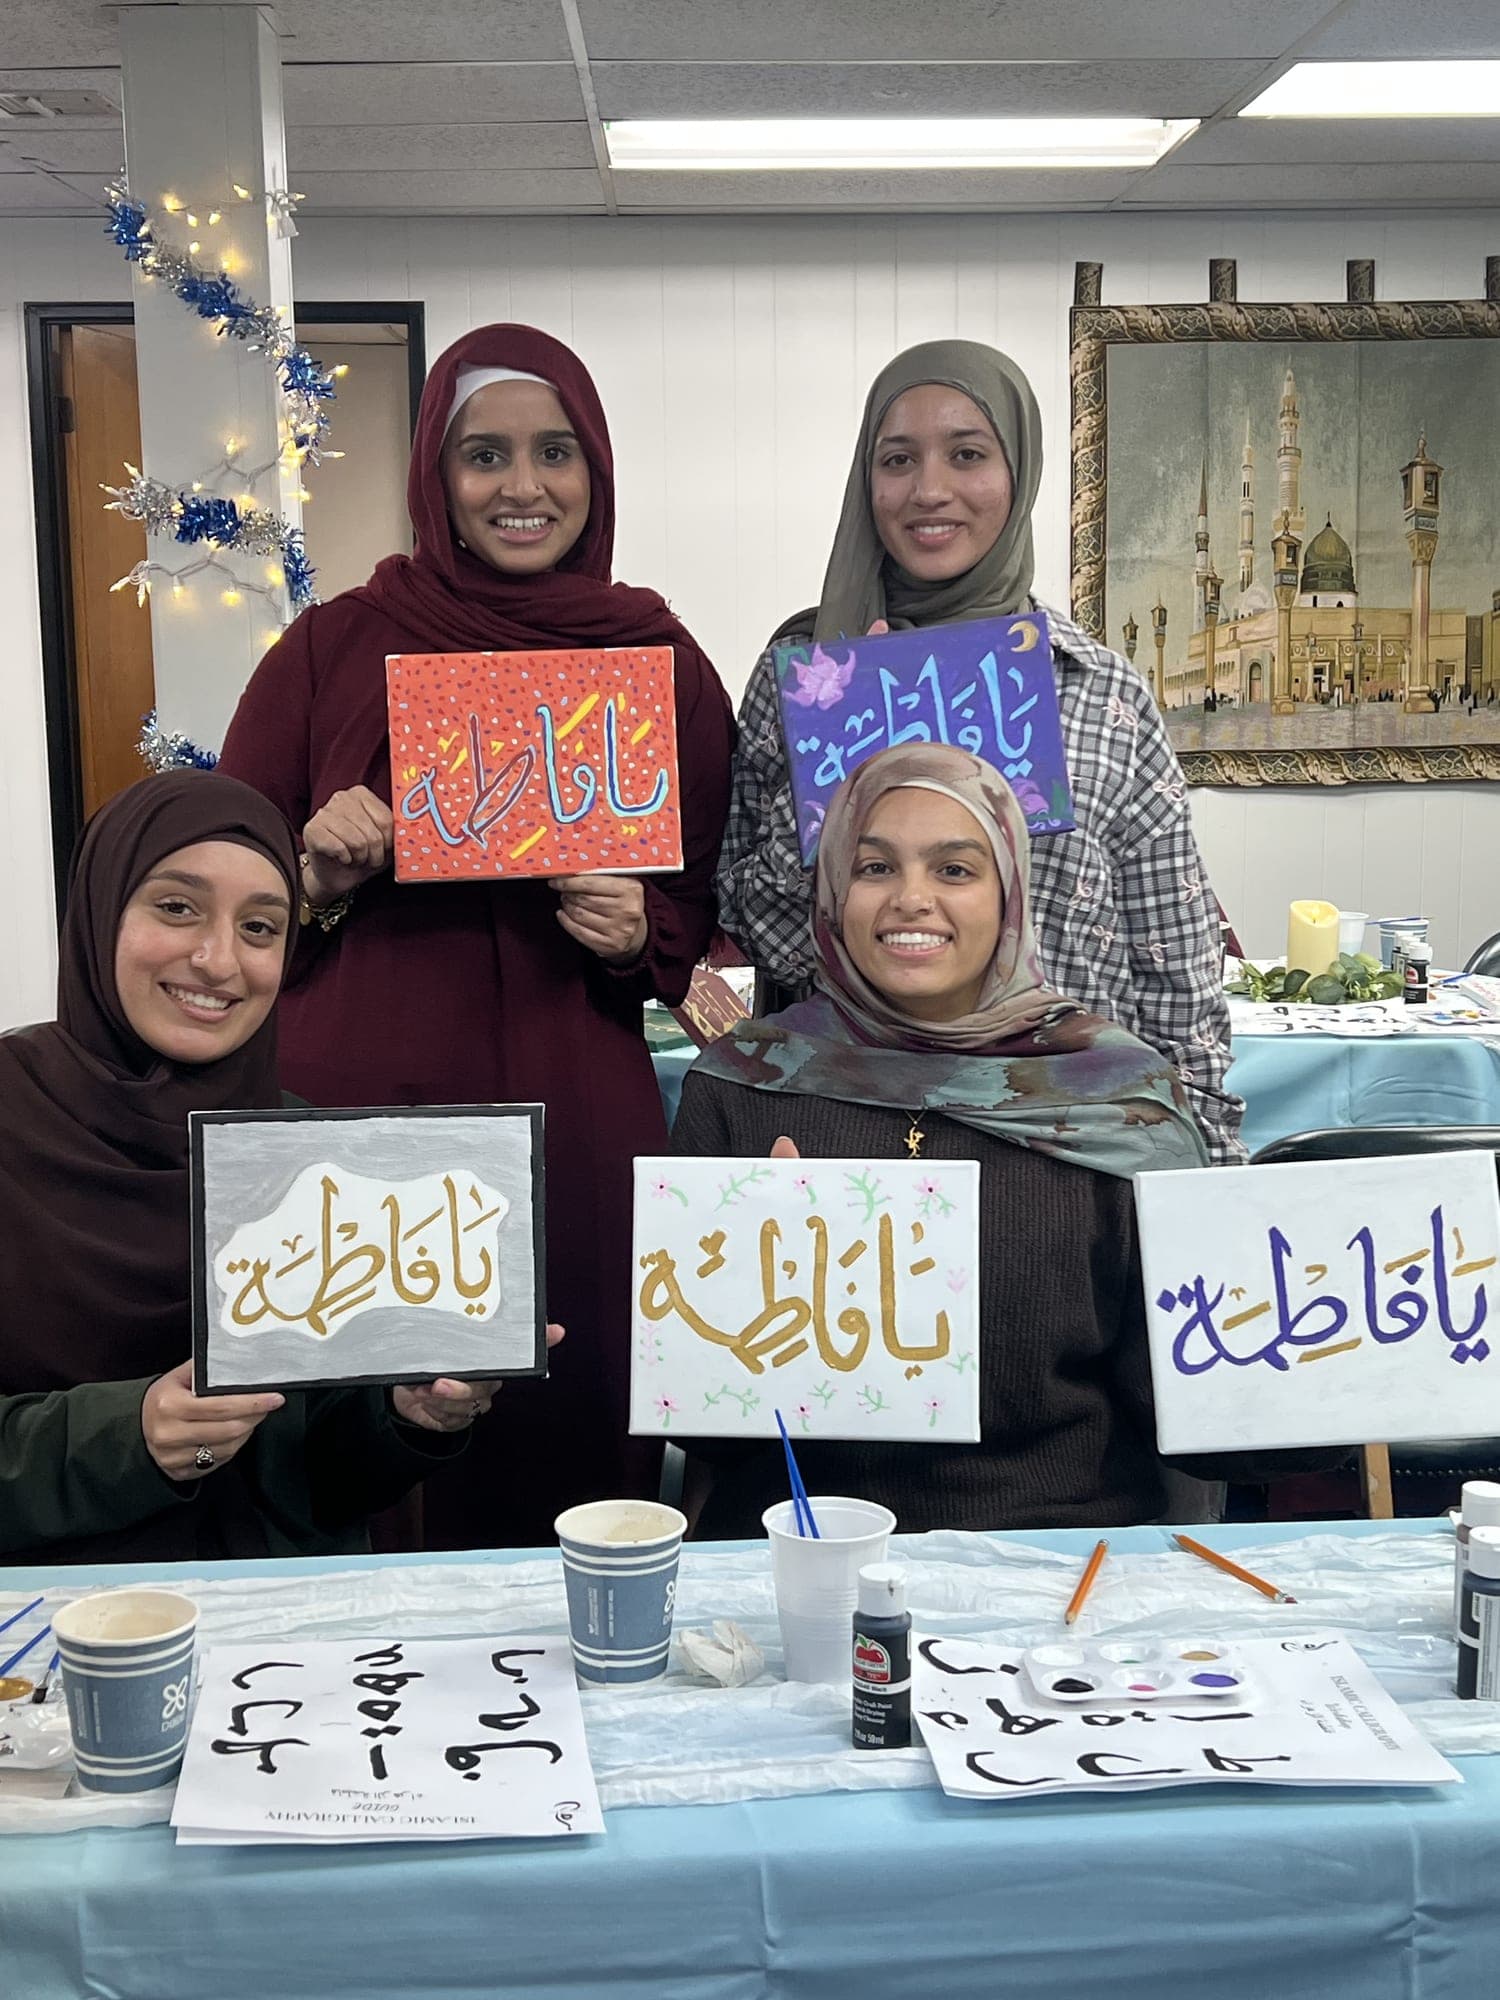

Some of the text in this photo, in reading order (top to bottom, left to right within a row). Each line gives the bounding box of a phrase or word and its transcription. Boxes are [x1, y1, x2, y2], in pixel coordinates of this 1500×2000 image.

[445, 1740, 563, 1781] ف
[265, 1811, 476, 1825] ISLAMIC CALLIGRAPHY
